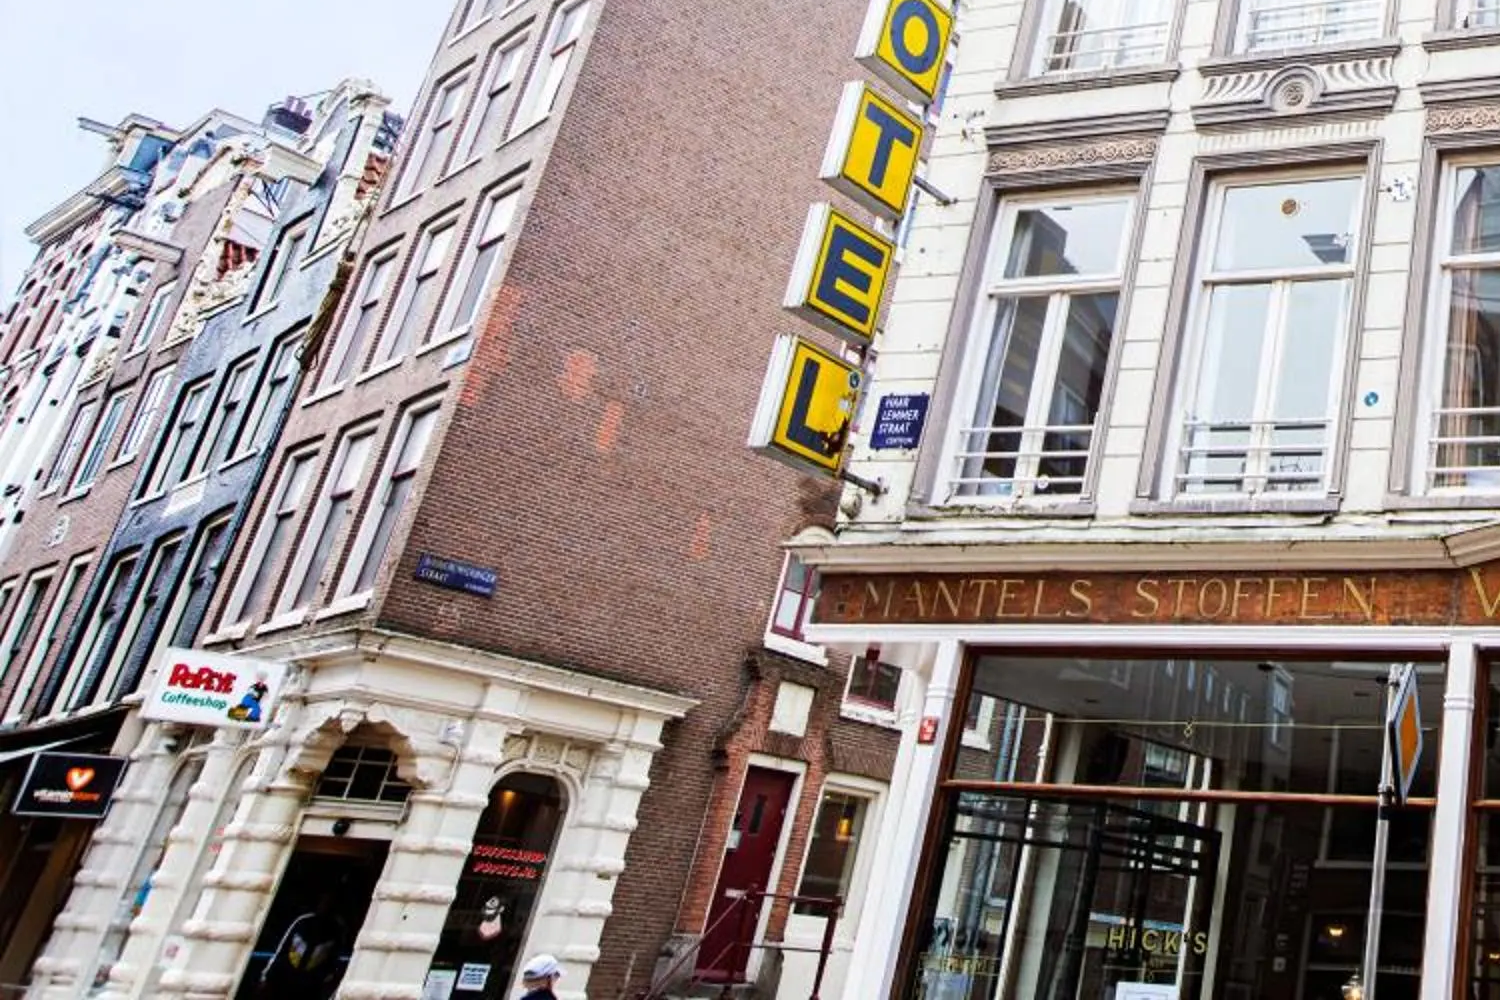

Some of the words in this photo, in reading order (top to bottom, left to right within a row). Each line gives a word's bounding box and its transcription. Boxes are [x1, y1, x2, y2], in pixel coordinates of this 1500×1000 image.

[882, 409, 919, 421] LEMMER
[878, 421, 911, 434] STRAAT
[860, 578, 1093, 618] MANTELS
[1132, 578, 1376, 620] STOFFEN
[161, 691, 227, 711] Coffeeshop
[1107, 926, 1207, 954] HICK'S
